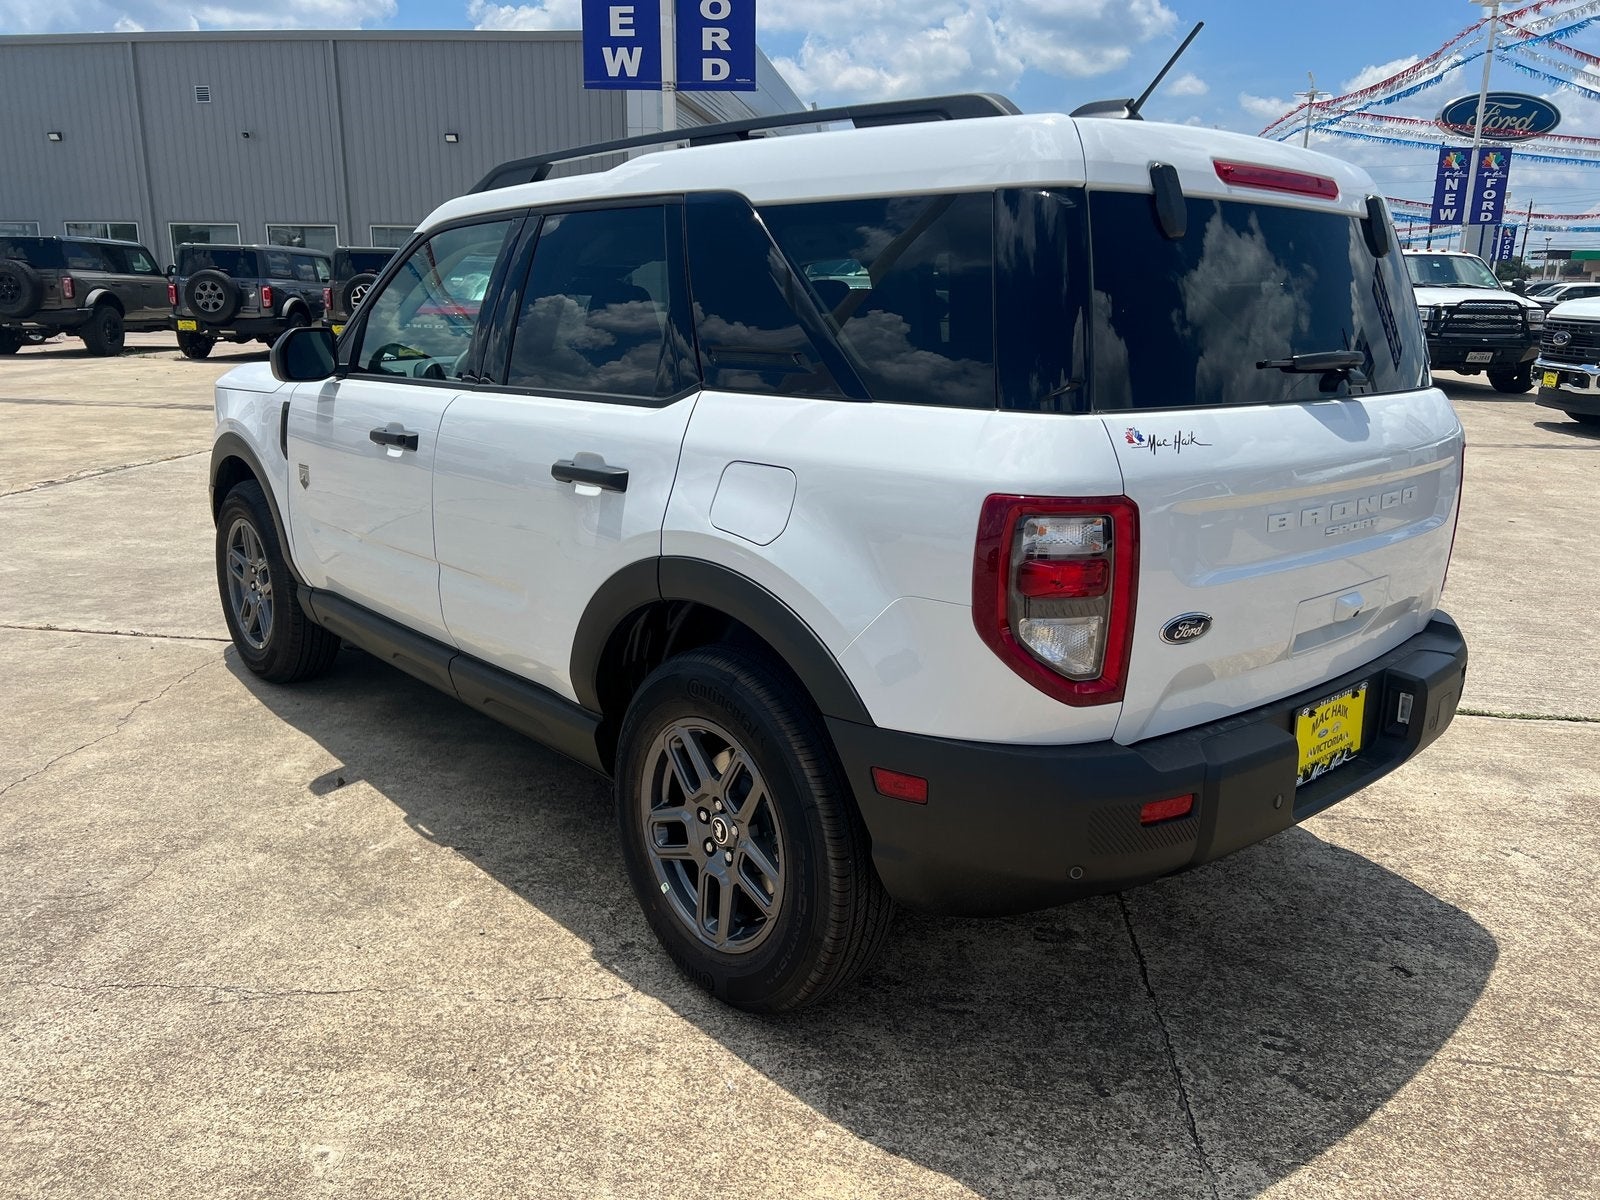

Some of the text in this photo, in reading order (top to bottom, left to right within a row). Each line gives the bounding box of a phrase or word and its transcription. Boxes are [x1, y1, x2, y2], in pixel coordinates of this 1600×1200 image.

[1467, 101, 1538, 131] Ford
[1440, 178, 1458, 220] NEW
[1480, 178, 1497, 221] FORD
[1502, 240, 1511, 260] FORD
[1143, 430, 1207, 455] Mac Haik
[1267, 486, 1419, 533] BRONCO
[1325, 516, 1377, 537] SPORT
[1174, 619, 1205, 639] Ford
[1311, 707, 1331, 736] MAC
[1331, 703, 1349, 719] HAIK
